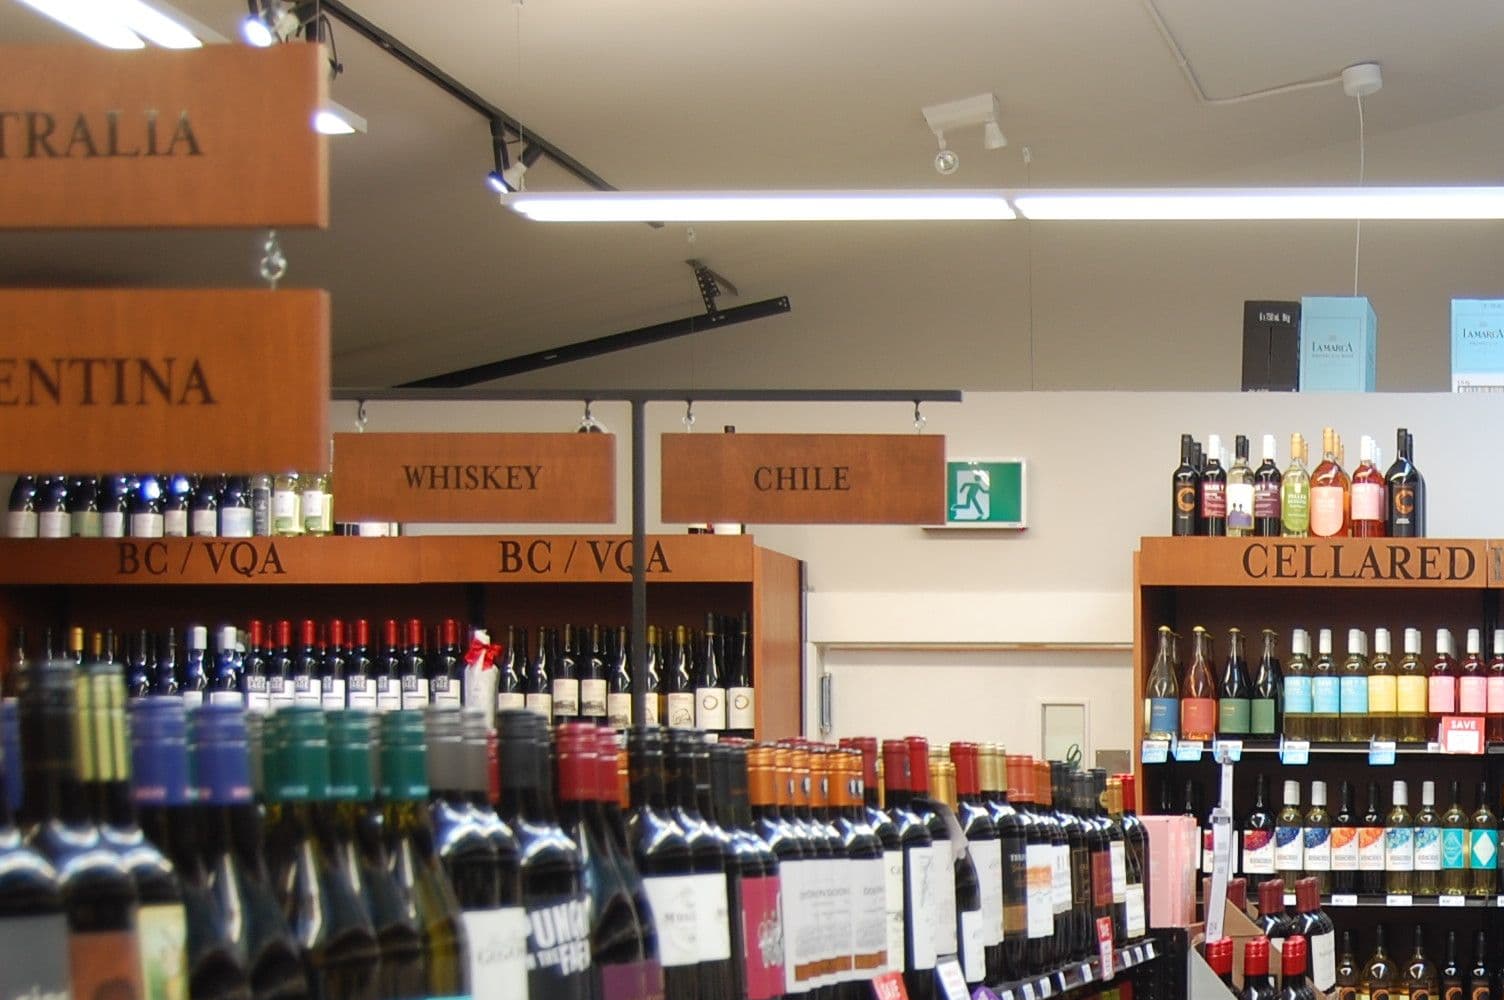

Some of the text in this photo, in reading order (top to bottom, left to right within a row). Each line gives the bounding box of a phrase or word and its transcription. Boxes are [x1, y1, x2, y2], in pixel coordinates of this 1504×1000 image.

[403, 464, 542, 492] WHISKEY
[754, 466, 851, 492] CHILE
[117, 541, 170, 576] BC
[202, 541, 287, 579] VQA
[498, 541, 551, 574] BC
[1243, 543, 1476, 581] CELLARED
[1451, 720, 1476, 729] SAVE
